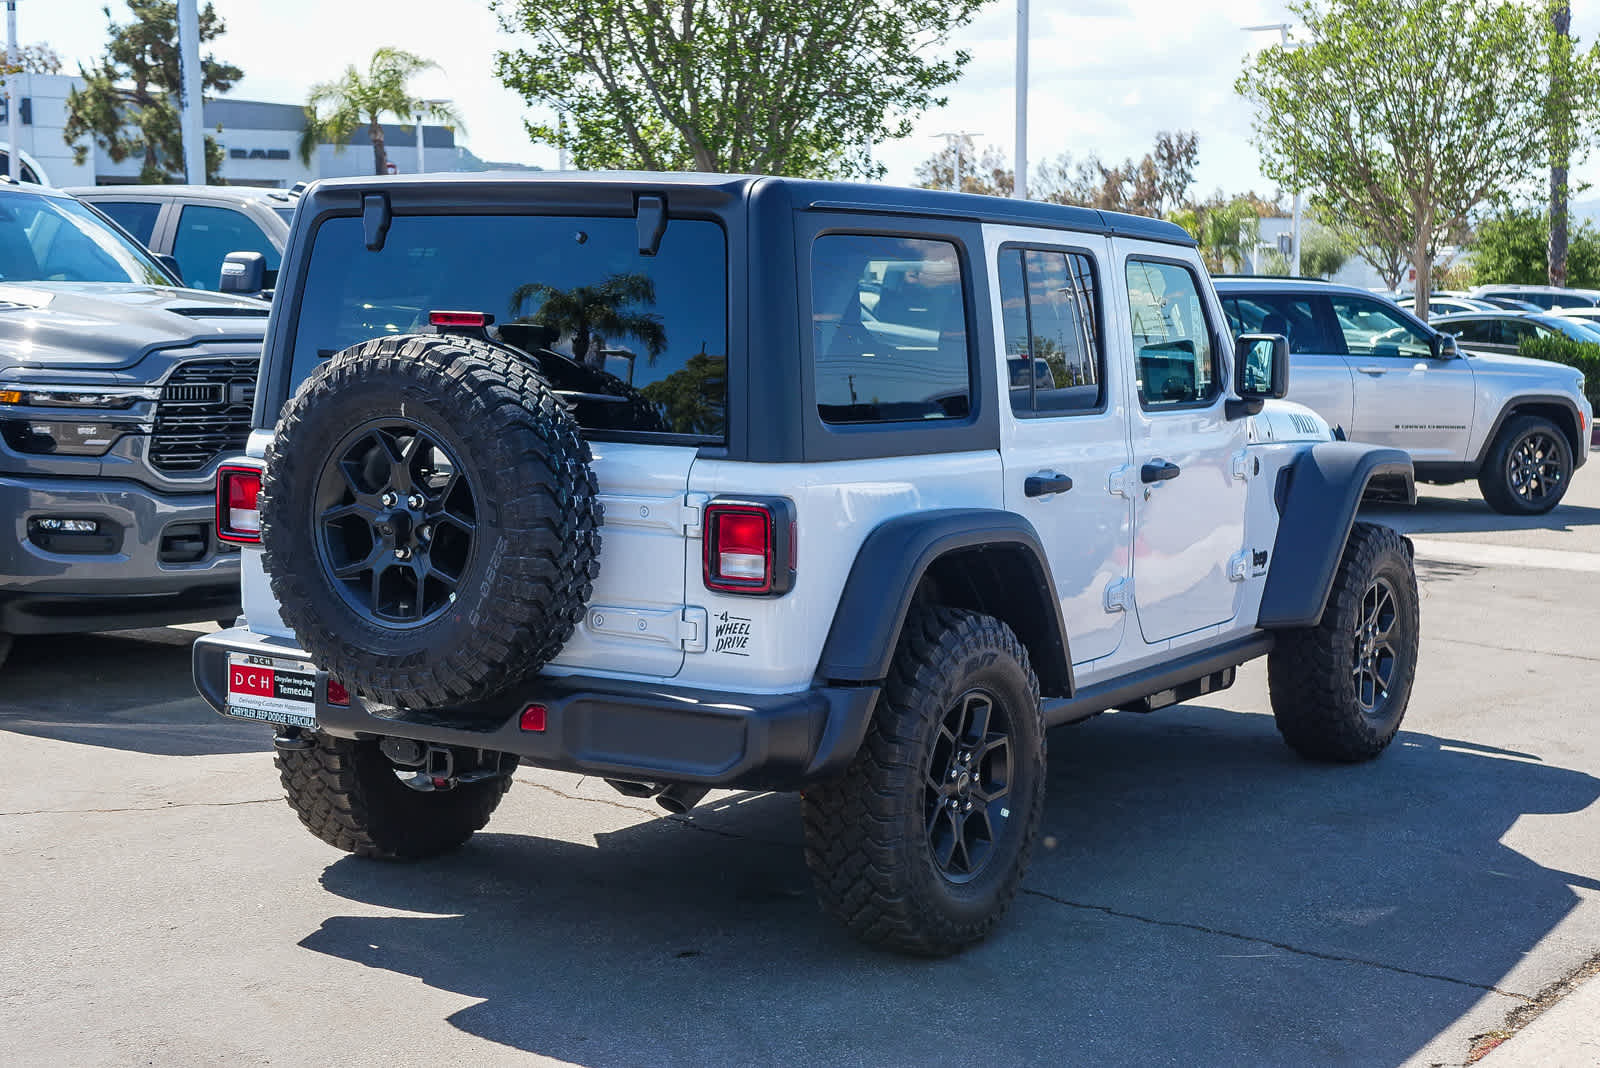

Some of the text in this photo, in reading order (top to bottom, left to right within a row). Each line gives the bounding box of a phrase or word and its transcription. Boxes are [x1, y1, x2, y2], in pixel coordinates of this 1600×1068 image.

[720, 611, 729, 623] 4
[715, 622, 751, 637] WHEEL
[715, 636, 749, 653] DRIVE
[279, 684, 313, 697] Temecula
[230, 706, 256, 718] CHRYSLER
[256, 709, 268, 720] JEEP
[268, 711, 287, 723] DODGE
